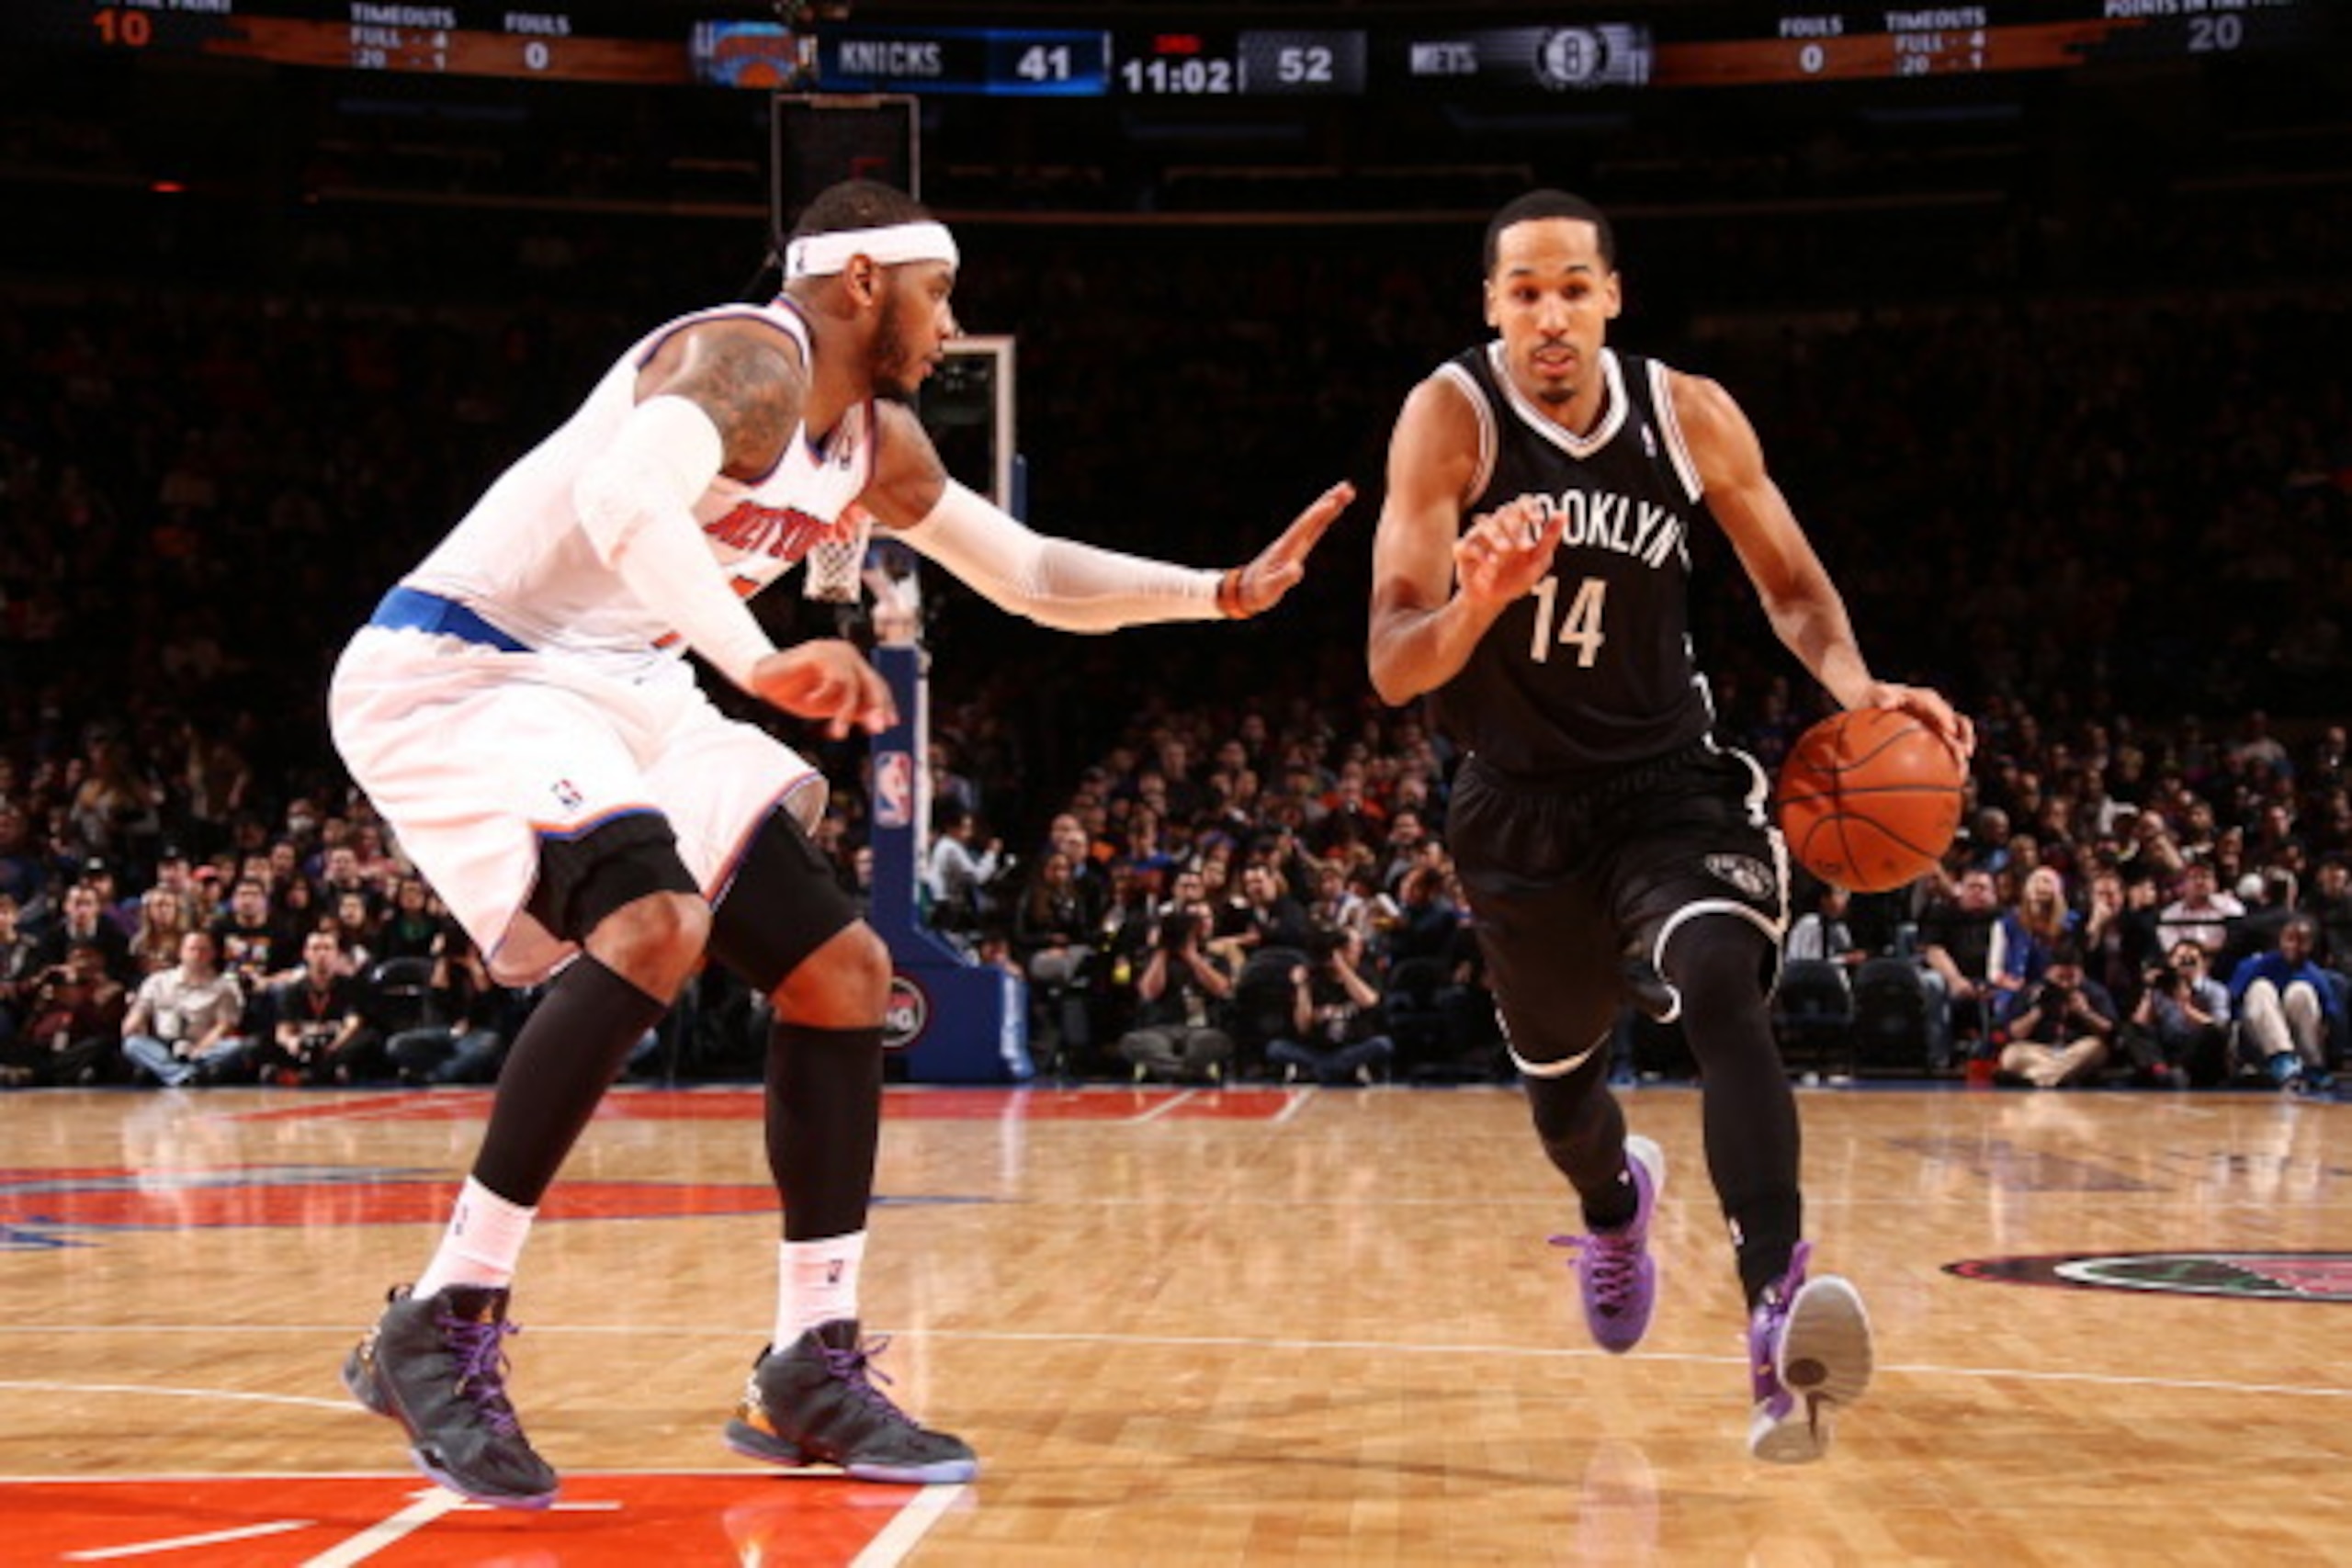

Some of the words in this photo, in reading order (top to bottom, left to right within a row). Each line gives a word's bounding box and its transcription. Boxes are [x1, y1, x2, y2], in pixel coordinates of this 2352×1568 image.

[93, 8, 152, 46] 10
[351, 4, 456, 28] TIMEOUTS
[505, 13, 571, 36] FOULS
[1780, 15, 1842, 38] FOULS
[1885, 6, 1986, 31] TIMEOUTS
[2188, 14, 2243, 51] 20
[524, 41, 548, 70] 0
[840, 40, 941, 76] KNICKS
[1017, 46, 1070, 81] 41
[1278, 47, 1332, 82] 52
[1800, 43, 1824, 73] 0
[1122, 59, 1232, 94] 11:02
[1530, 575, 1607, 668] 14
